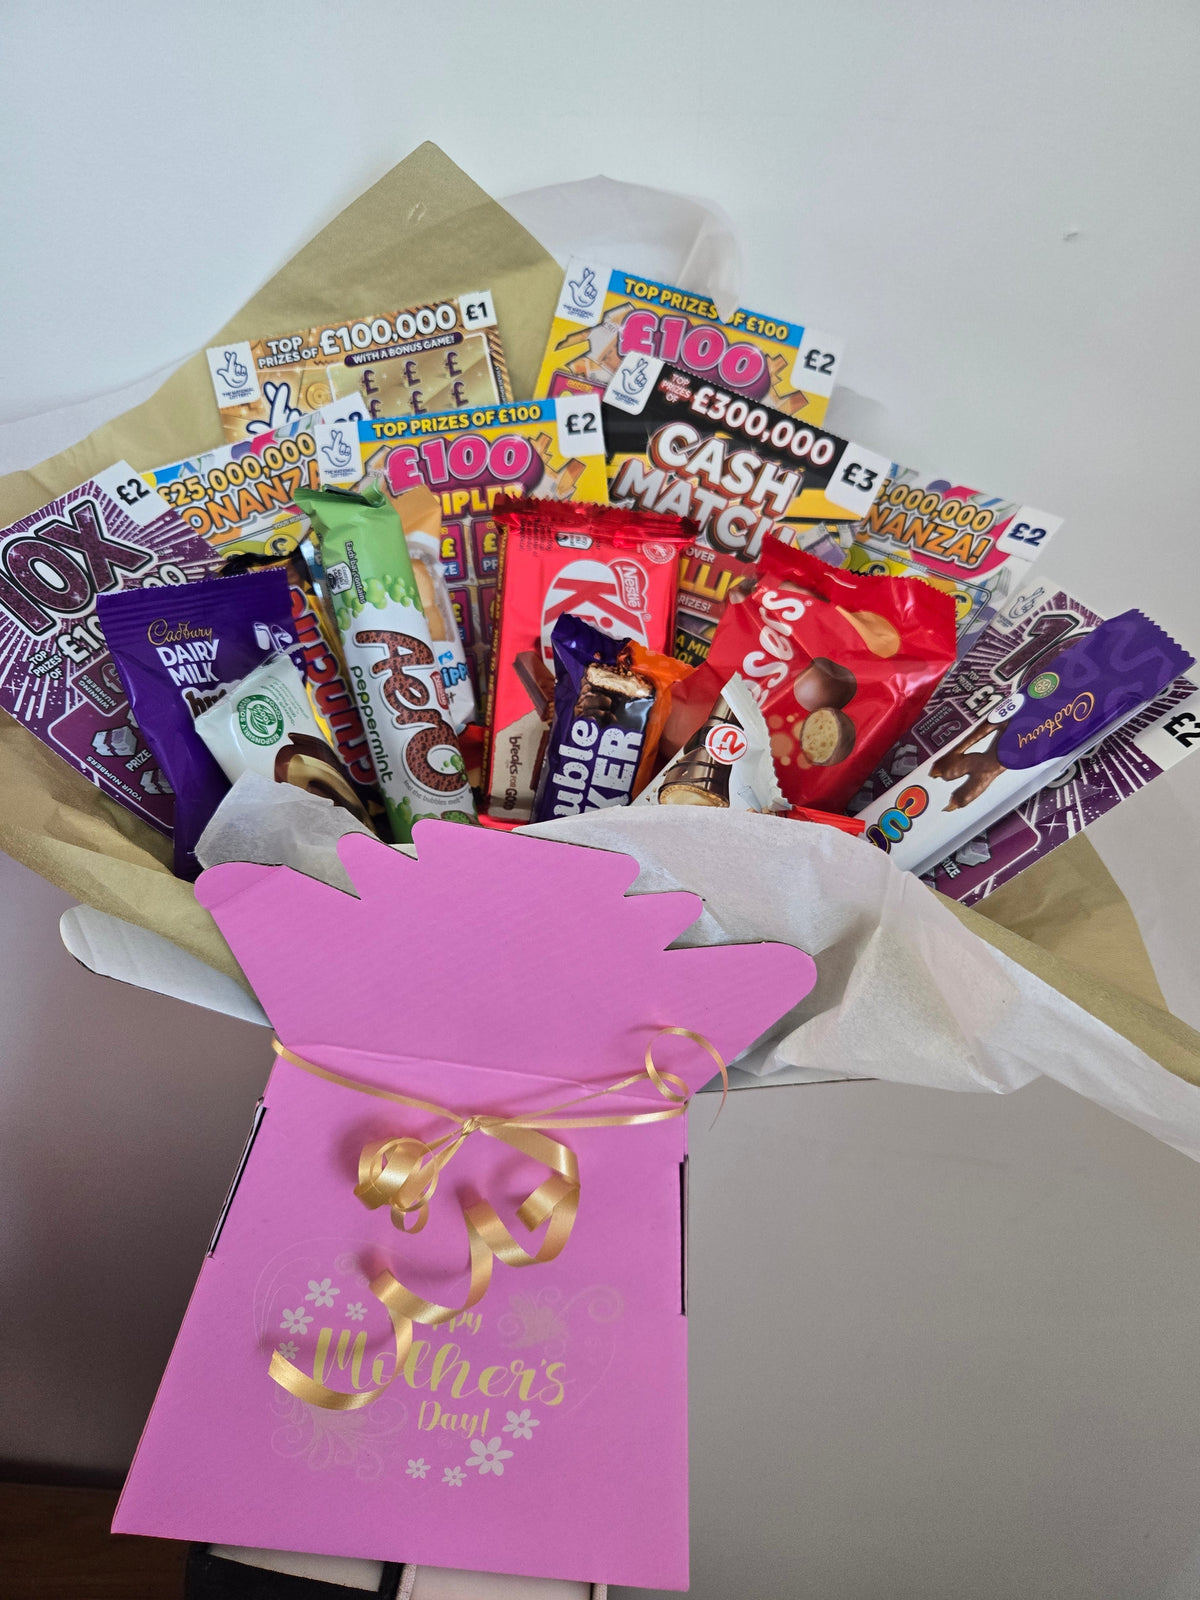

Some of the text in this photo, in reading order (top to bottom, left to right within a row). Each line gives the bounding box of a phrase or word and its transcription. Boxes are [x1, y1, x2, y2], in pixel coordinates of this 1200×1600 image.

[466, 302, 489, 321] £1
[624, 277, 659, 301] TOP
[660, 289, 718, 321] PRIZES
[746, 317, 788, 341] £100
[320, 303, 457, 356] £100,000
[258, 347, 318, 370] PRIZES OF
[267, 335, 303, 355] TOP
[352, 335, 456, 365] WITH A BONUS GAME!
[619, 309, 766, 388] £100
[804, 349, 836, 376] £2
[661, 380, 691, 400] PRIZES
[671, 373, 690, 387] TOP
[665, 392, 678, 404] OF
[372, 404, 542, 439] TOP PRIZES OF £100
[565, 411, 598, 436] £2
[691, 385, 835, 466] £300,000
[385, 434, 533, 498] £100
[650, 421, 802, 517] CASH
[841, 462, 878, 492] £3
[117, 478, 151, 506] £2
[181, 459, 321, 536] ONANZ
[856, 504, 992, 566] NANZA!
[1007, 522, 1047, 547] £2
[685, 547, 716, 564] OVER
[615, 566, 641, 609] Nestlé
[679, 594, 712, 613] RIZES!
[147, 618, 213, 646] Cadbury
[28, 650, 48, 665] TOP
[32, 654, 62, 678] PRIZES
[156, 638, 220, 667] DAIRY
[49, 667, 62, 680] OF
[167, 662, 220, 687] MILK
[956, 675, 977, 692] PRIZES
[968, 670, 980, 681] TOP
[78, 680, 110, 710] WINNING
[82, 674, 117, 707] NUMBERS
[965, 685, 1002, 718] £1
[350, 665, 393, 784] peppermint
[1016, 691, 1095, 749] Cadbury
[1162, 712, 1200, 748] £2
[125, 749, 152, 772] PRIZE
[509, 733, 523, 775] breaks
[552, 720, 598, 816] uble
[86, 755, 143, 802] YOUR NUMBERS
[584, 727, 643, 813] KER
[877, 768, 894, 788] PRIZE
[418, 1400, 491, 1439] Day!
